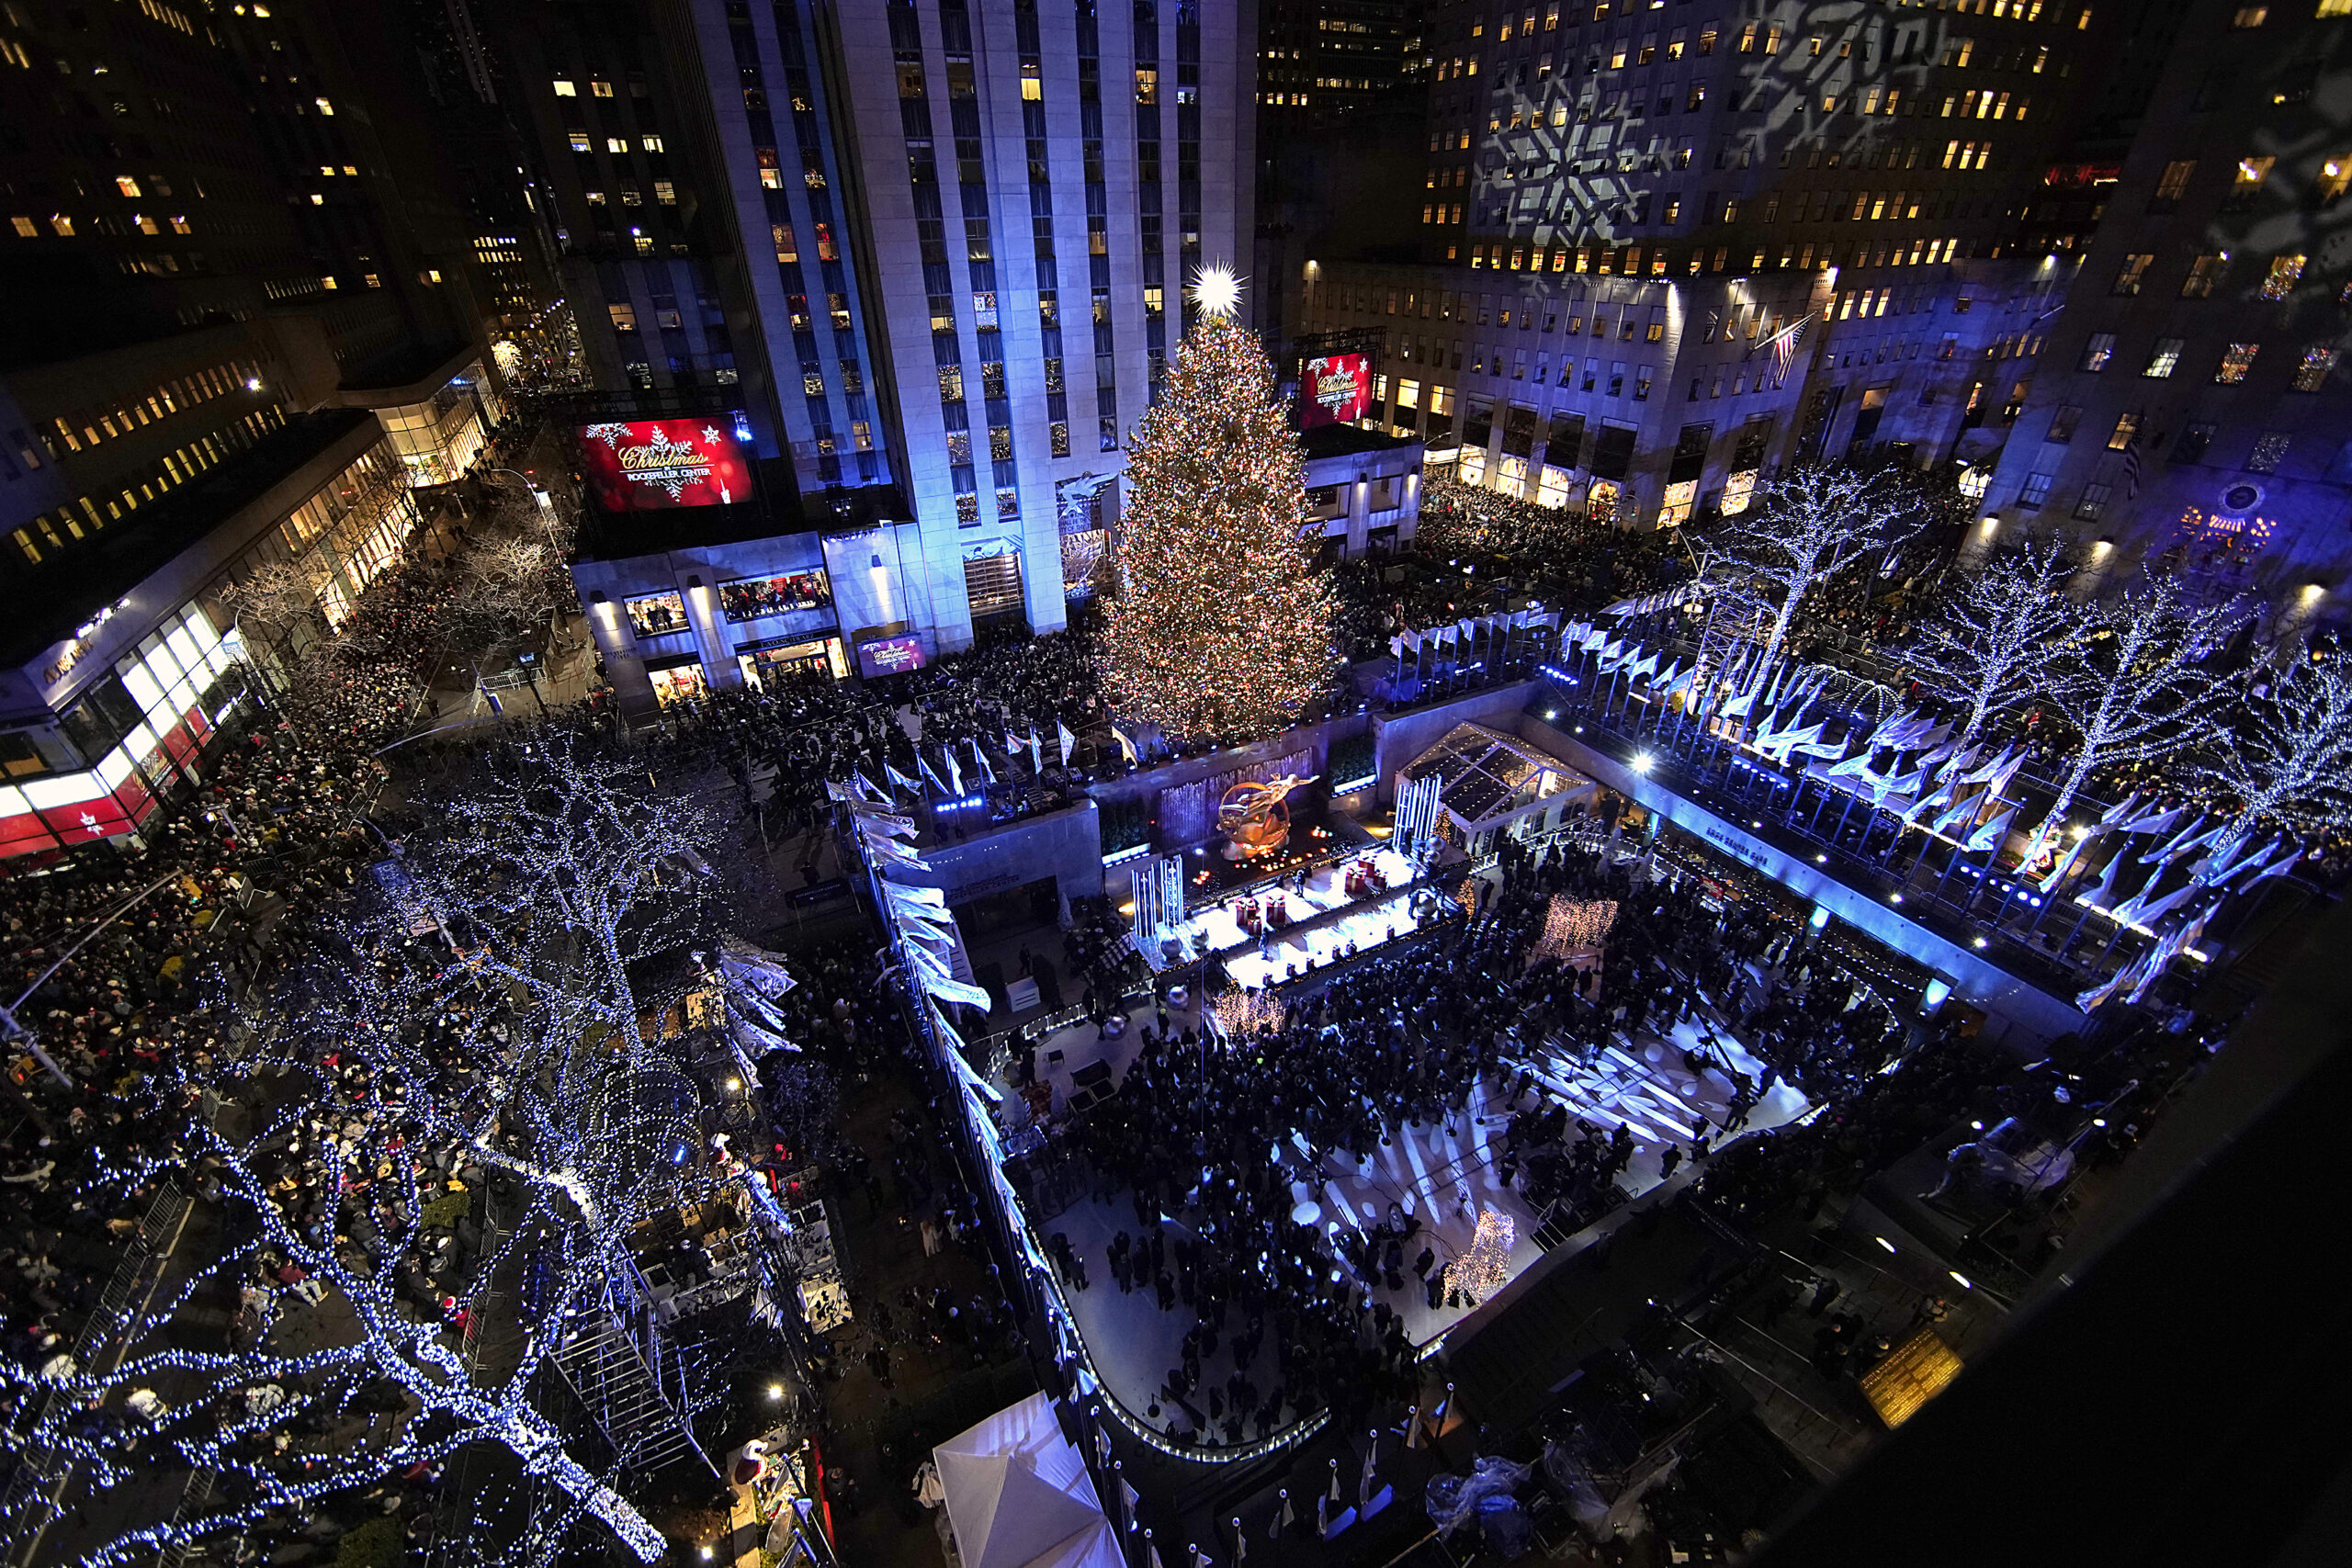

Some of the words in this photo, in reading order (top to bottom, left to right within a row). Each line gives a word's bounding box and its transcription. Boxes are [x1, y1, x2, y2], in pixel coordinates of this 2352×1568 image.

[1317, 376, 1358, 394] Christmas
[618, 446, 709, 469] Christmas
[627, 469, 680, 481] ROCKEFELLER
[681, 468, 712, 478] CENTER
